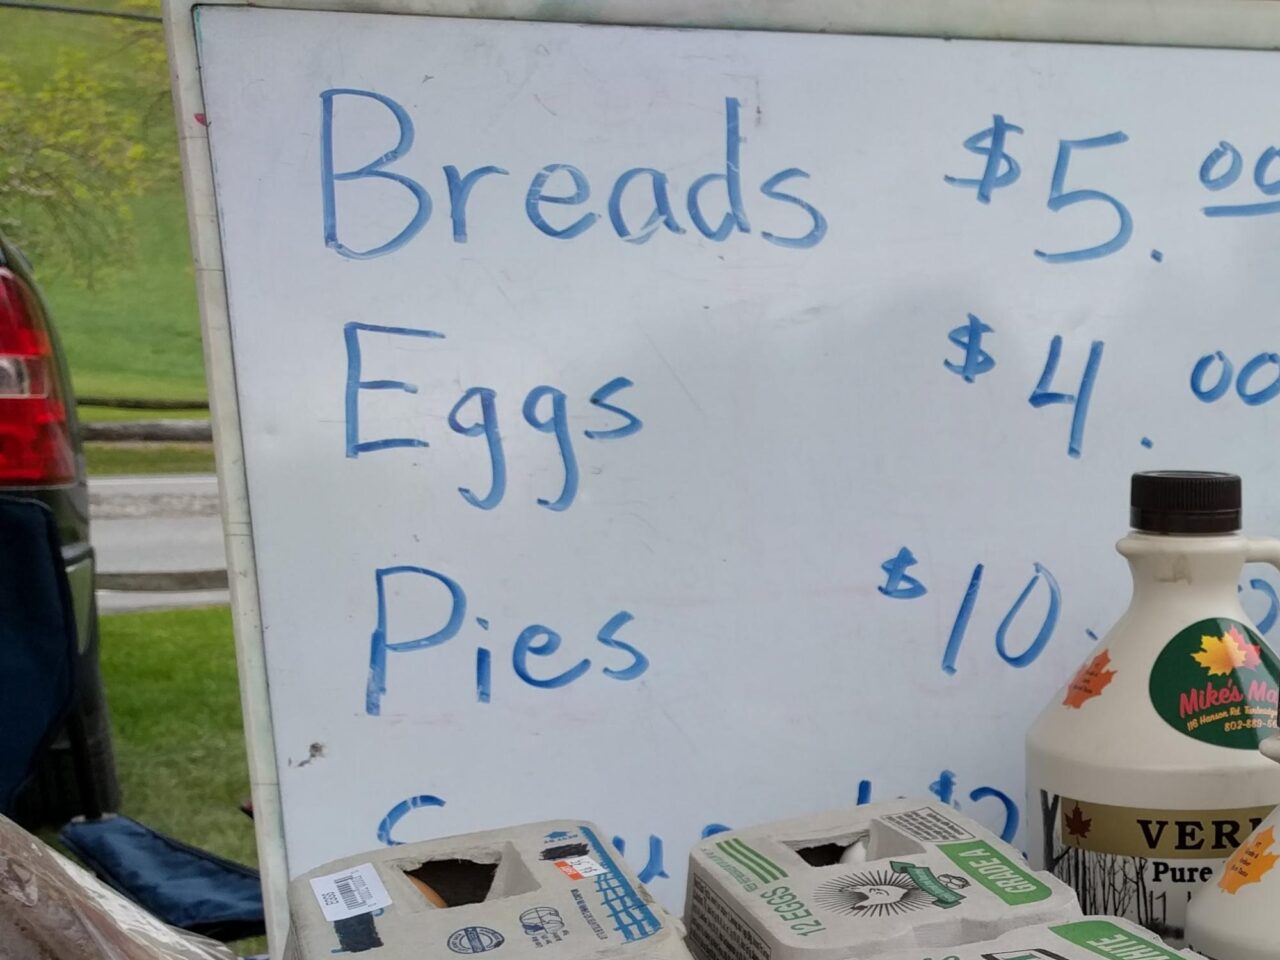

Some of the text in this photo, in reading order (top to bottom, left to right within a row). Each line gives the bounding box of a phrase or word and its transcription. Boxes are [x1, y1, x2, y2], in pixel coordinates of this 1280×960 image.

[318, 88, 828, 259] Breads
[344, 321, 644, 511] Eggs
[365, 565, 650, 716] Pies
[1179, 679, 1279, 720] Mike's Ma
[1200, 710, 1228, 726] Hanson
[957, 844, 989, 861] A
[1137, 817, 1264, 850] VER
[970, 849, 1037, 898] GRADE
[1152, 861, 1213, 883] Pure
[758, 881, 827, 940] 12 EGGS
